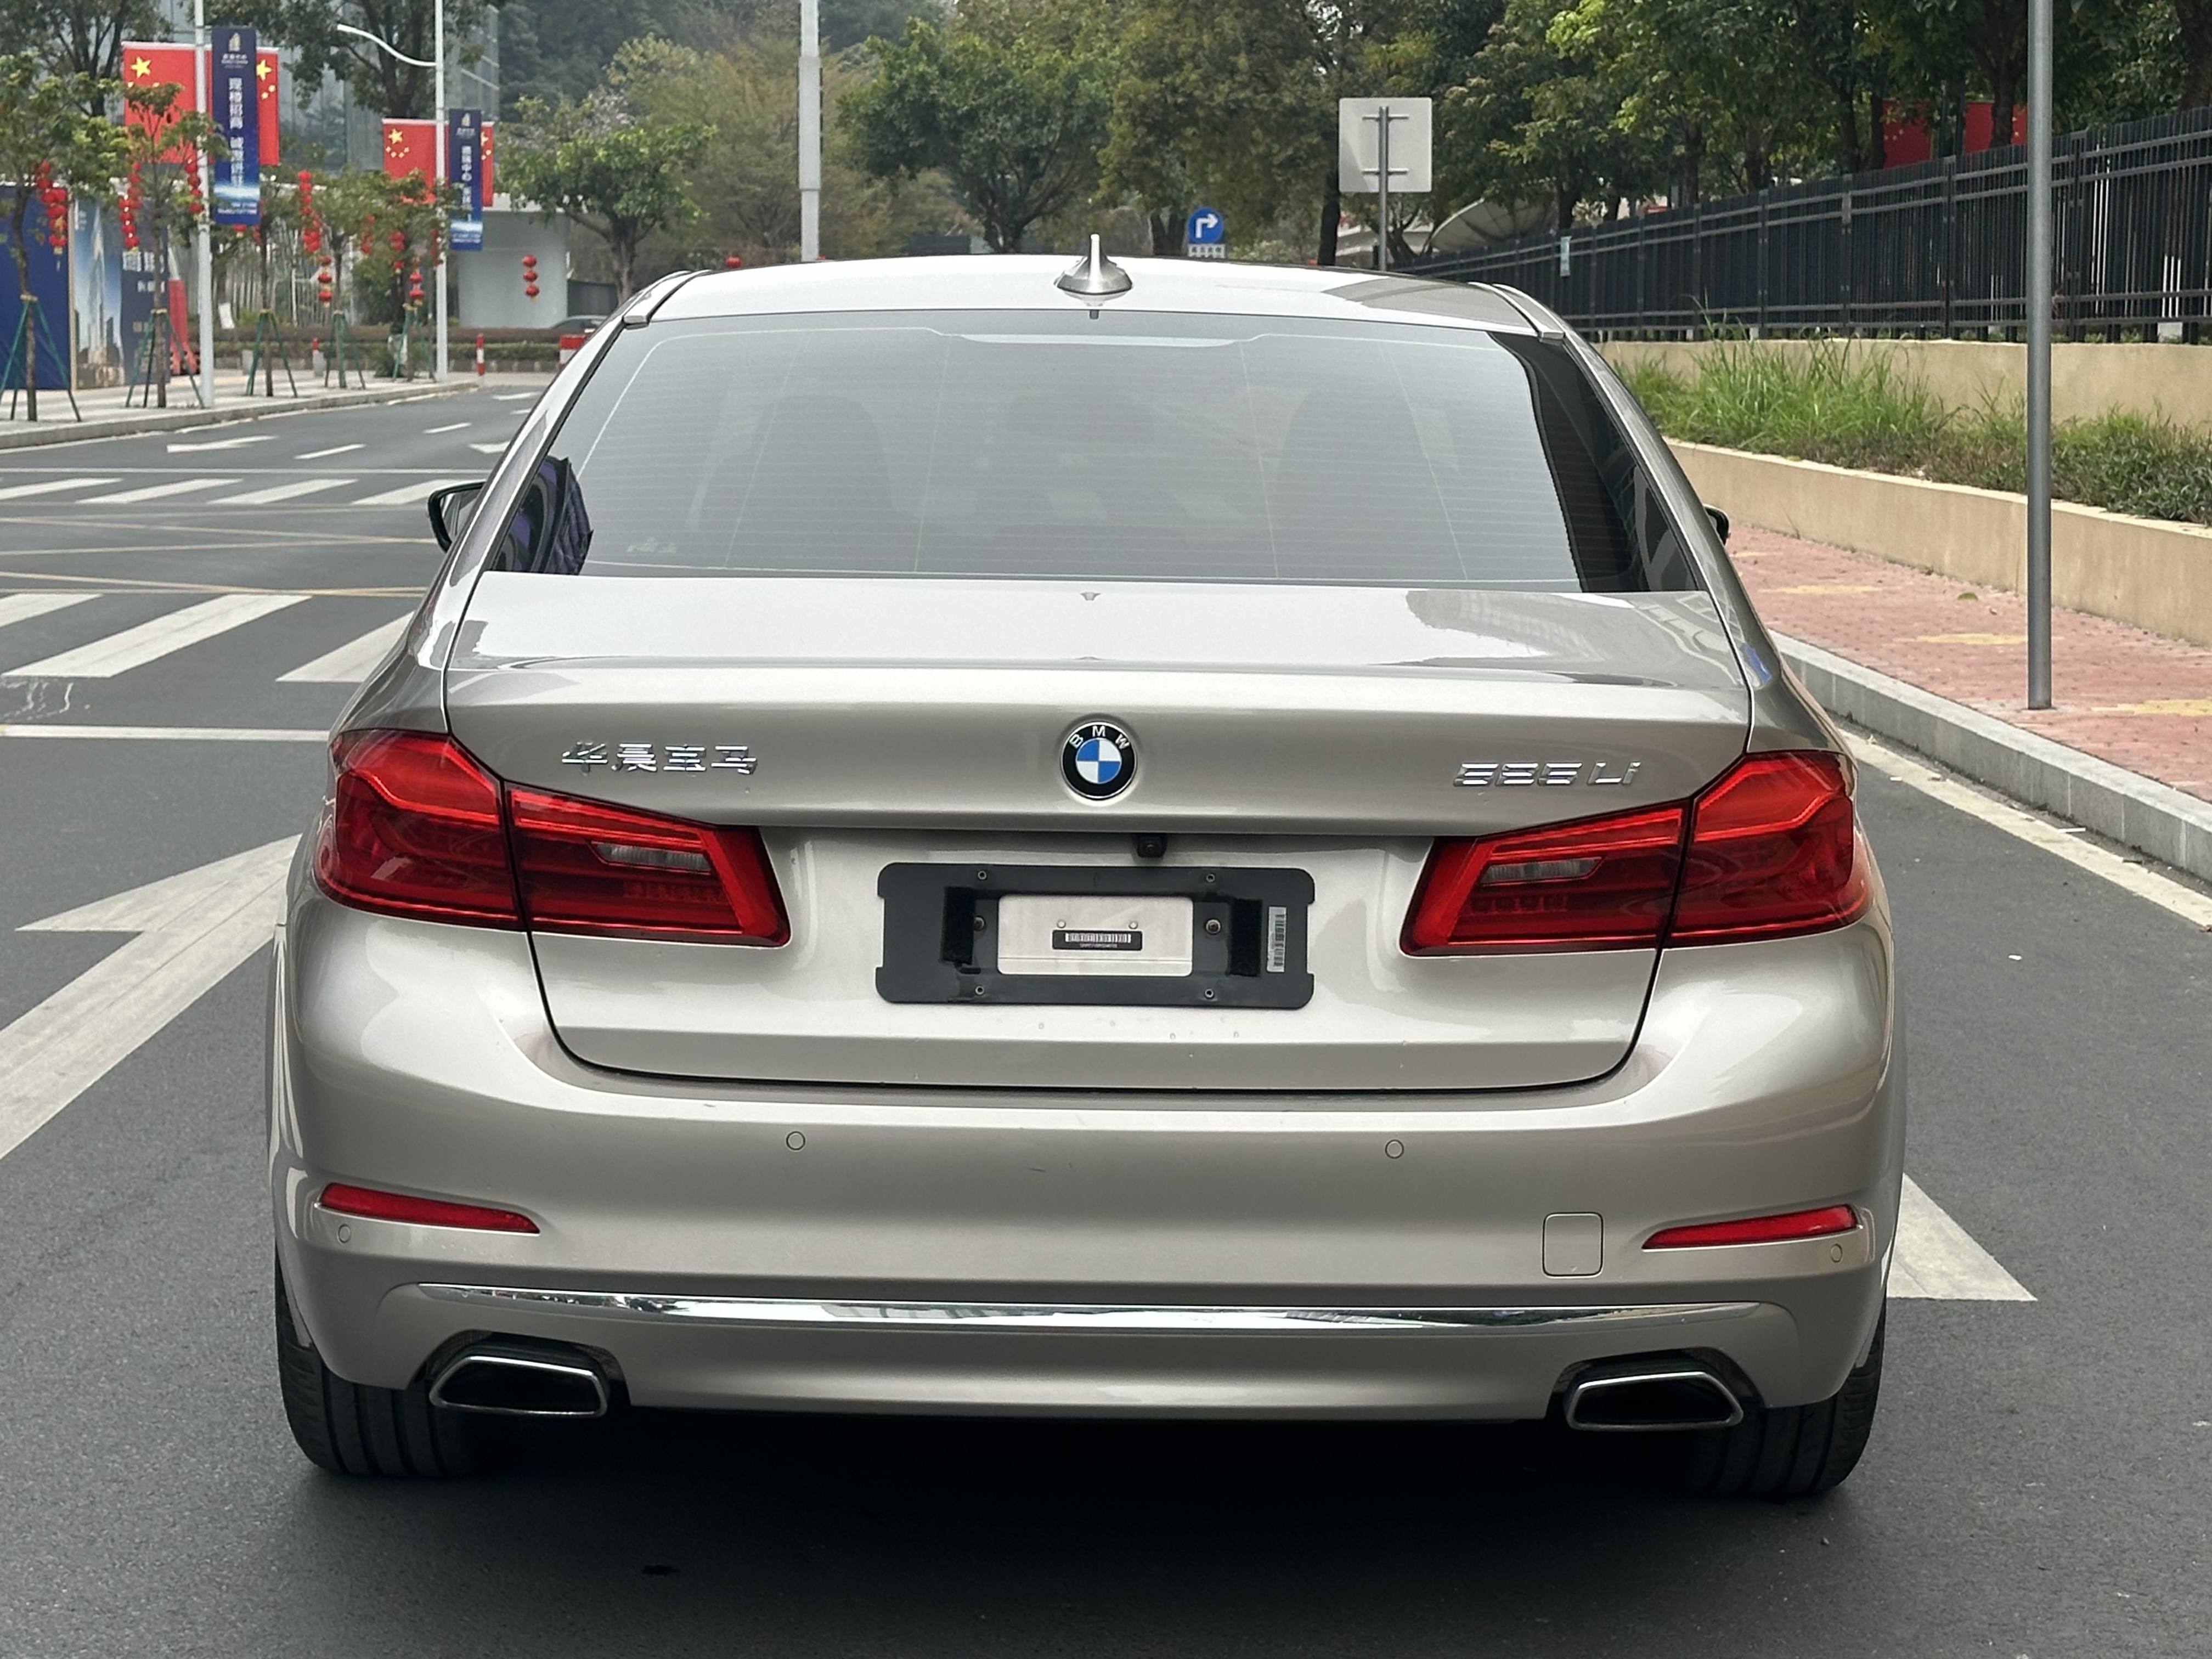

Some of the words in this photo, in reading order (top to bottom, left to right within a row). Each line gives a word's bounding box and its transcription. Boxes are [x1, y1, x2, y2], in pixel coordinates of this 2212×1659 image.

[1069, 725, 1130, 749] BMW
[562, 741, 757, 776] 华晨宝马
